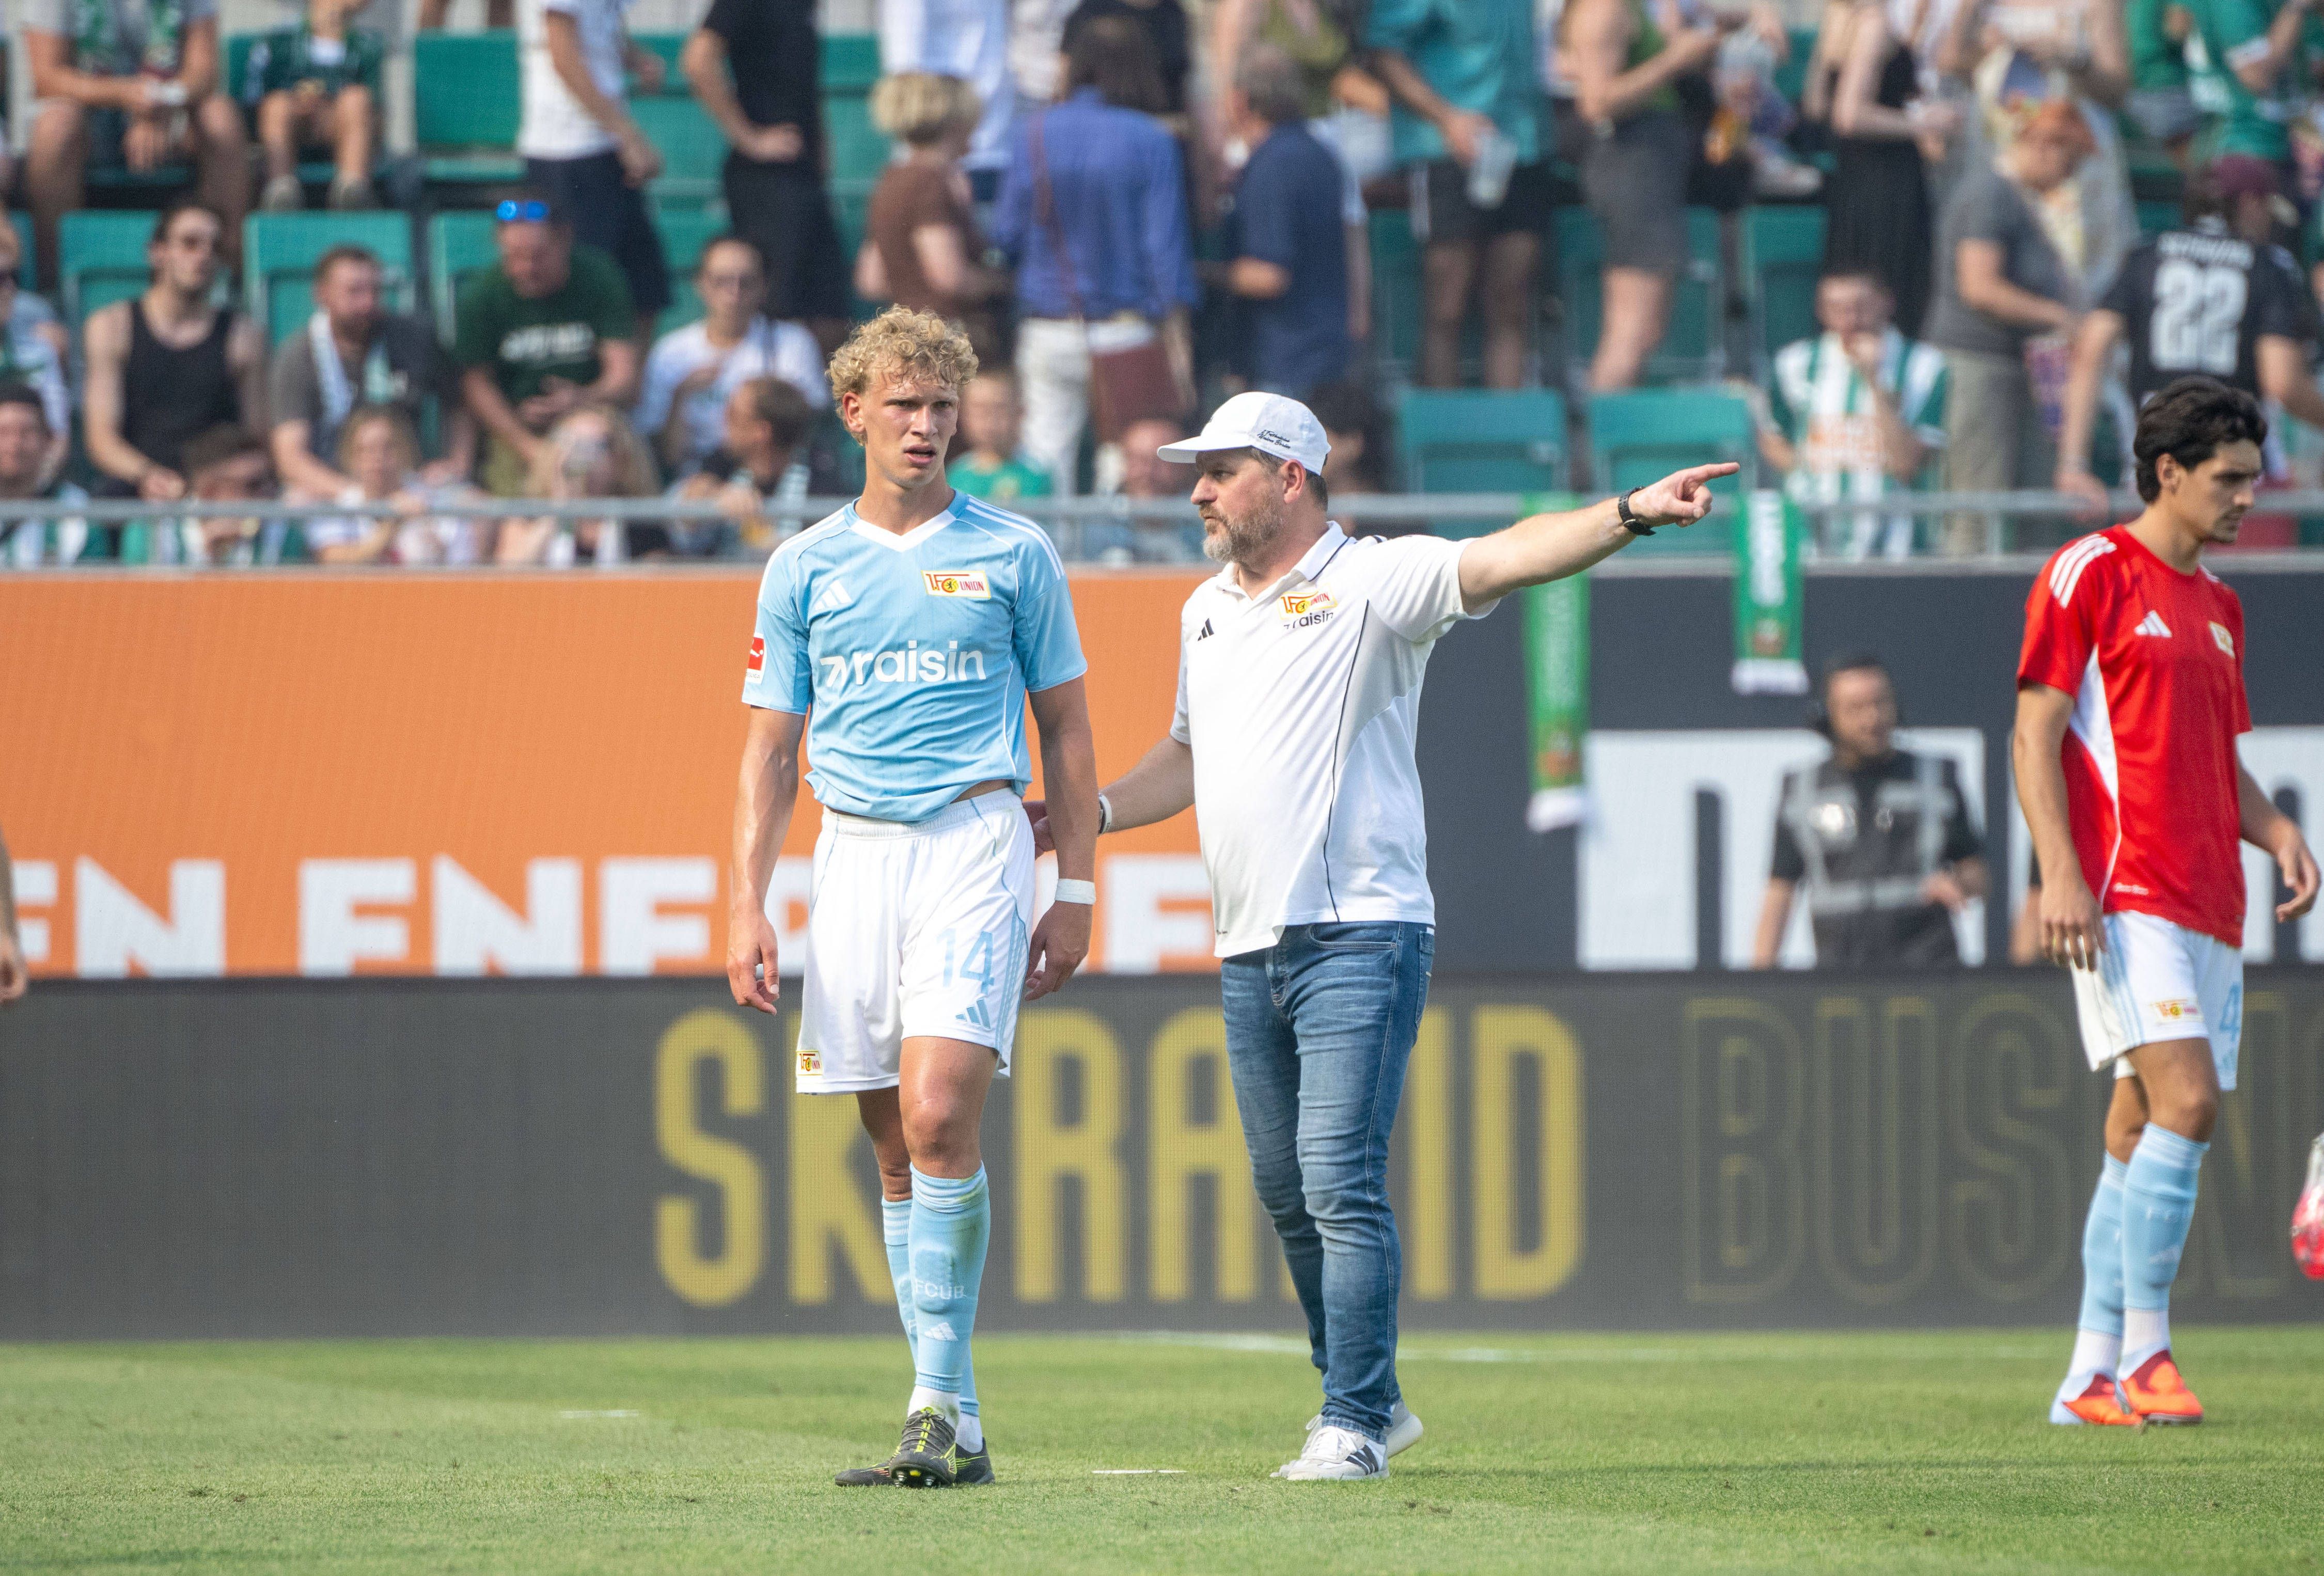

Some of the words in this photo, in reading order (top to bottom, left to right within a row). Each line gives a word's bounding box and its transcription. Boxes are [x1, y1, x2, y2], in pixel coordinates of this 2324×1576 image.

[2151, 259, 2248, 375] 22
[960, 580, 984, 591] UNION
[1292, 610, 1334, 629] raisin
[851, 640, 987, 685] raisin
[936, 929, 994, 995] 14
[655, 1006, 898, 1305] SK
[1015, 1004, 1583, 1303] RAID
